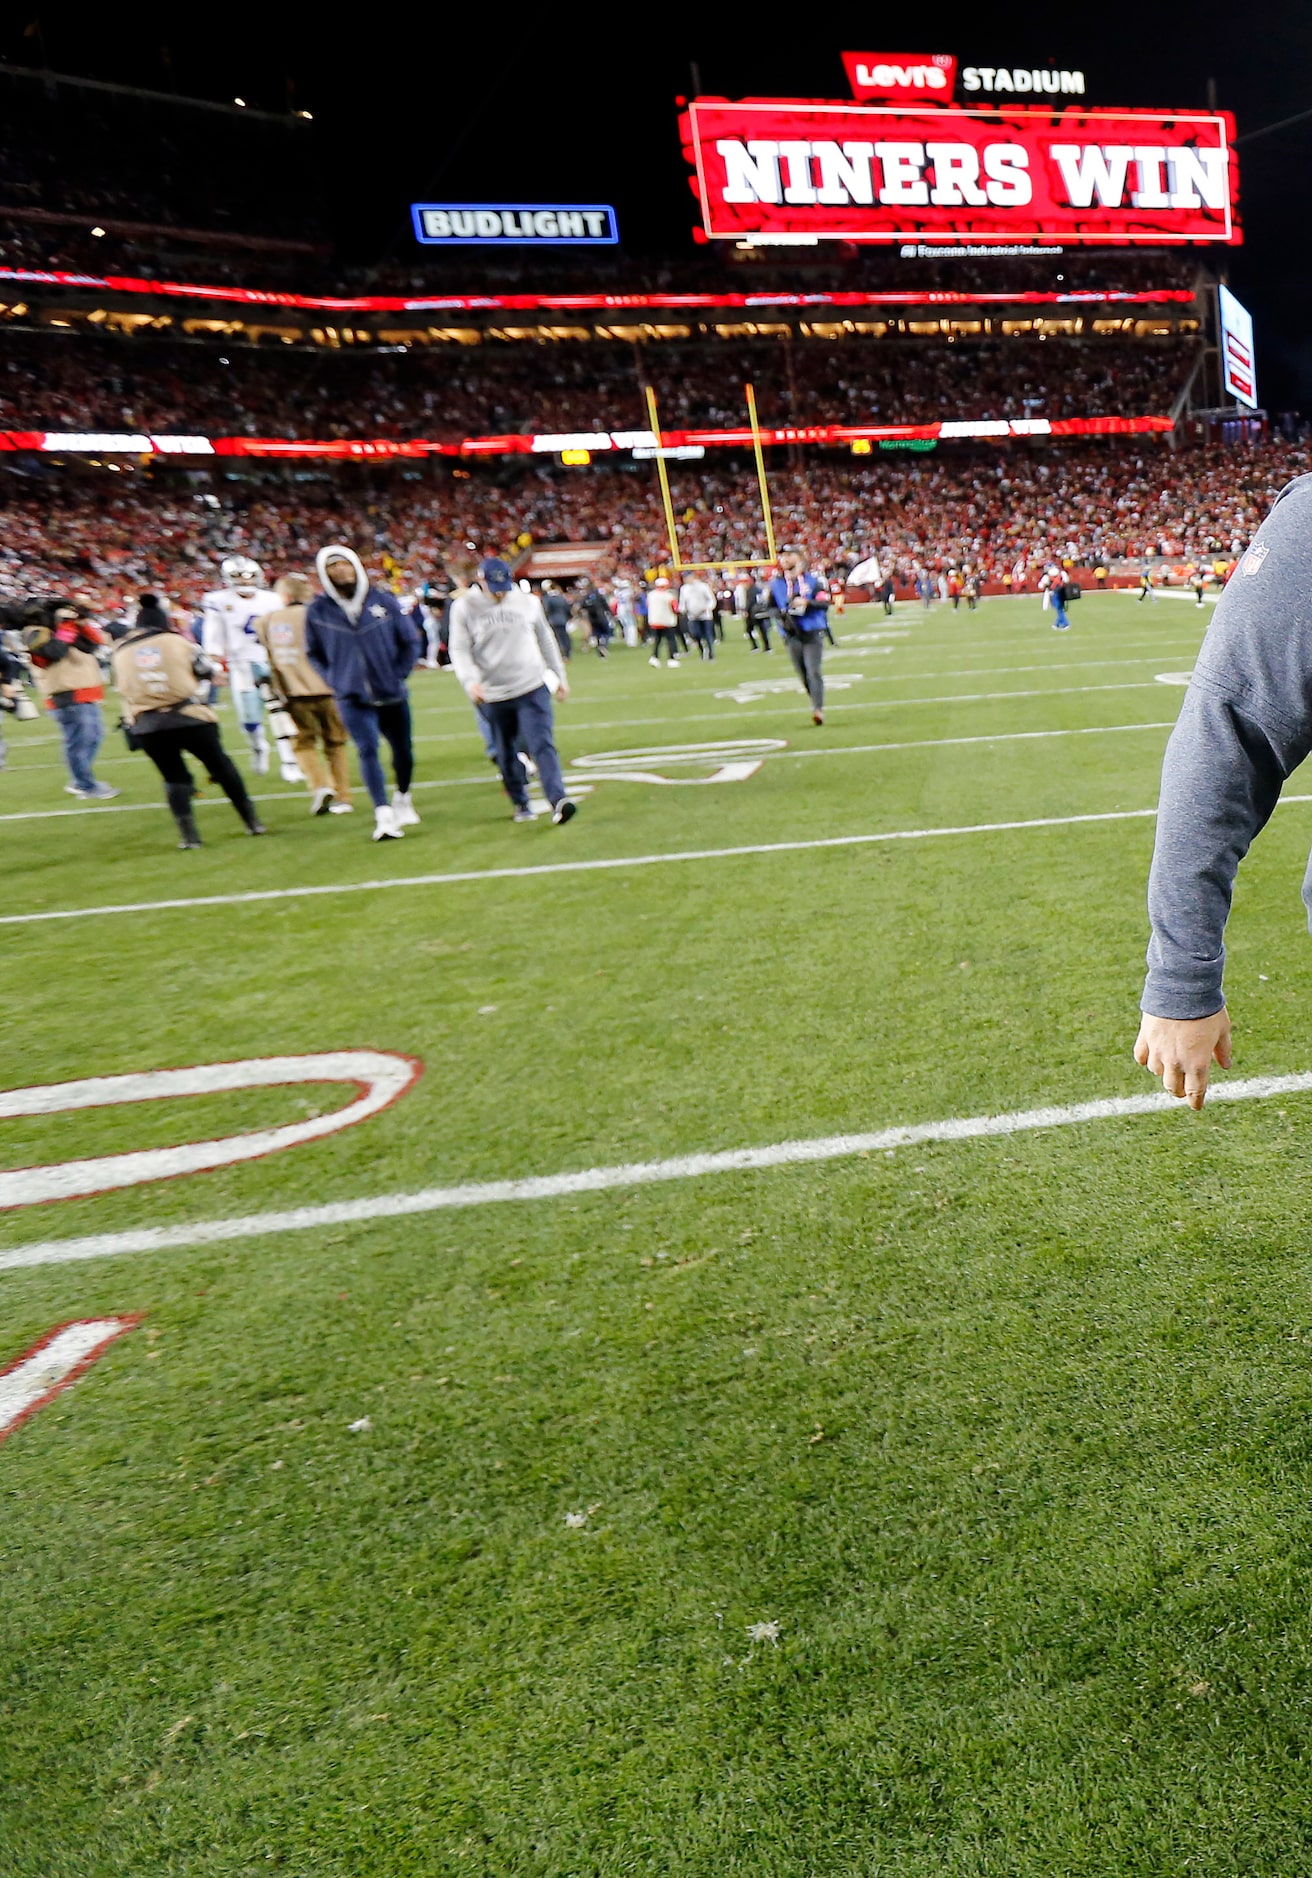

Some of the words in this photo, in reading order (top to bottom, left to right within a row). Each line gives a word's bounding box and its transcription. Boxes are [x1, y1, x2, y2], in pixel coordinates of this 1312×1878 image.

[962, 67, 1086, 95] STADIUM
[716, 139, 1033, 206] NINERS
[1050, 143, 1229, 208] WIN
